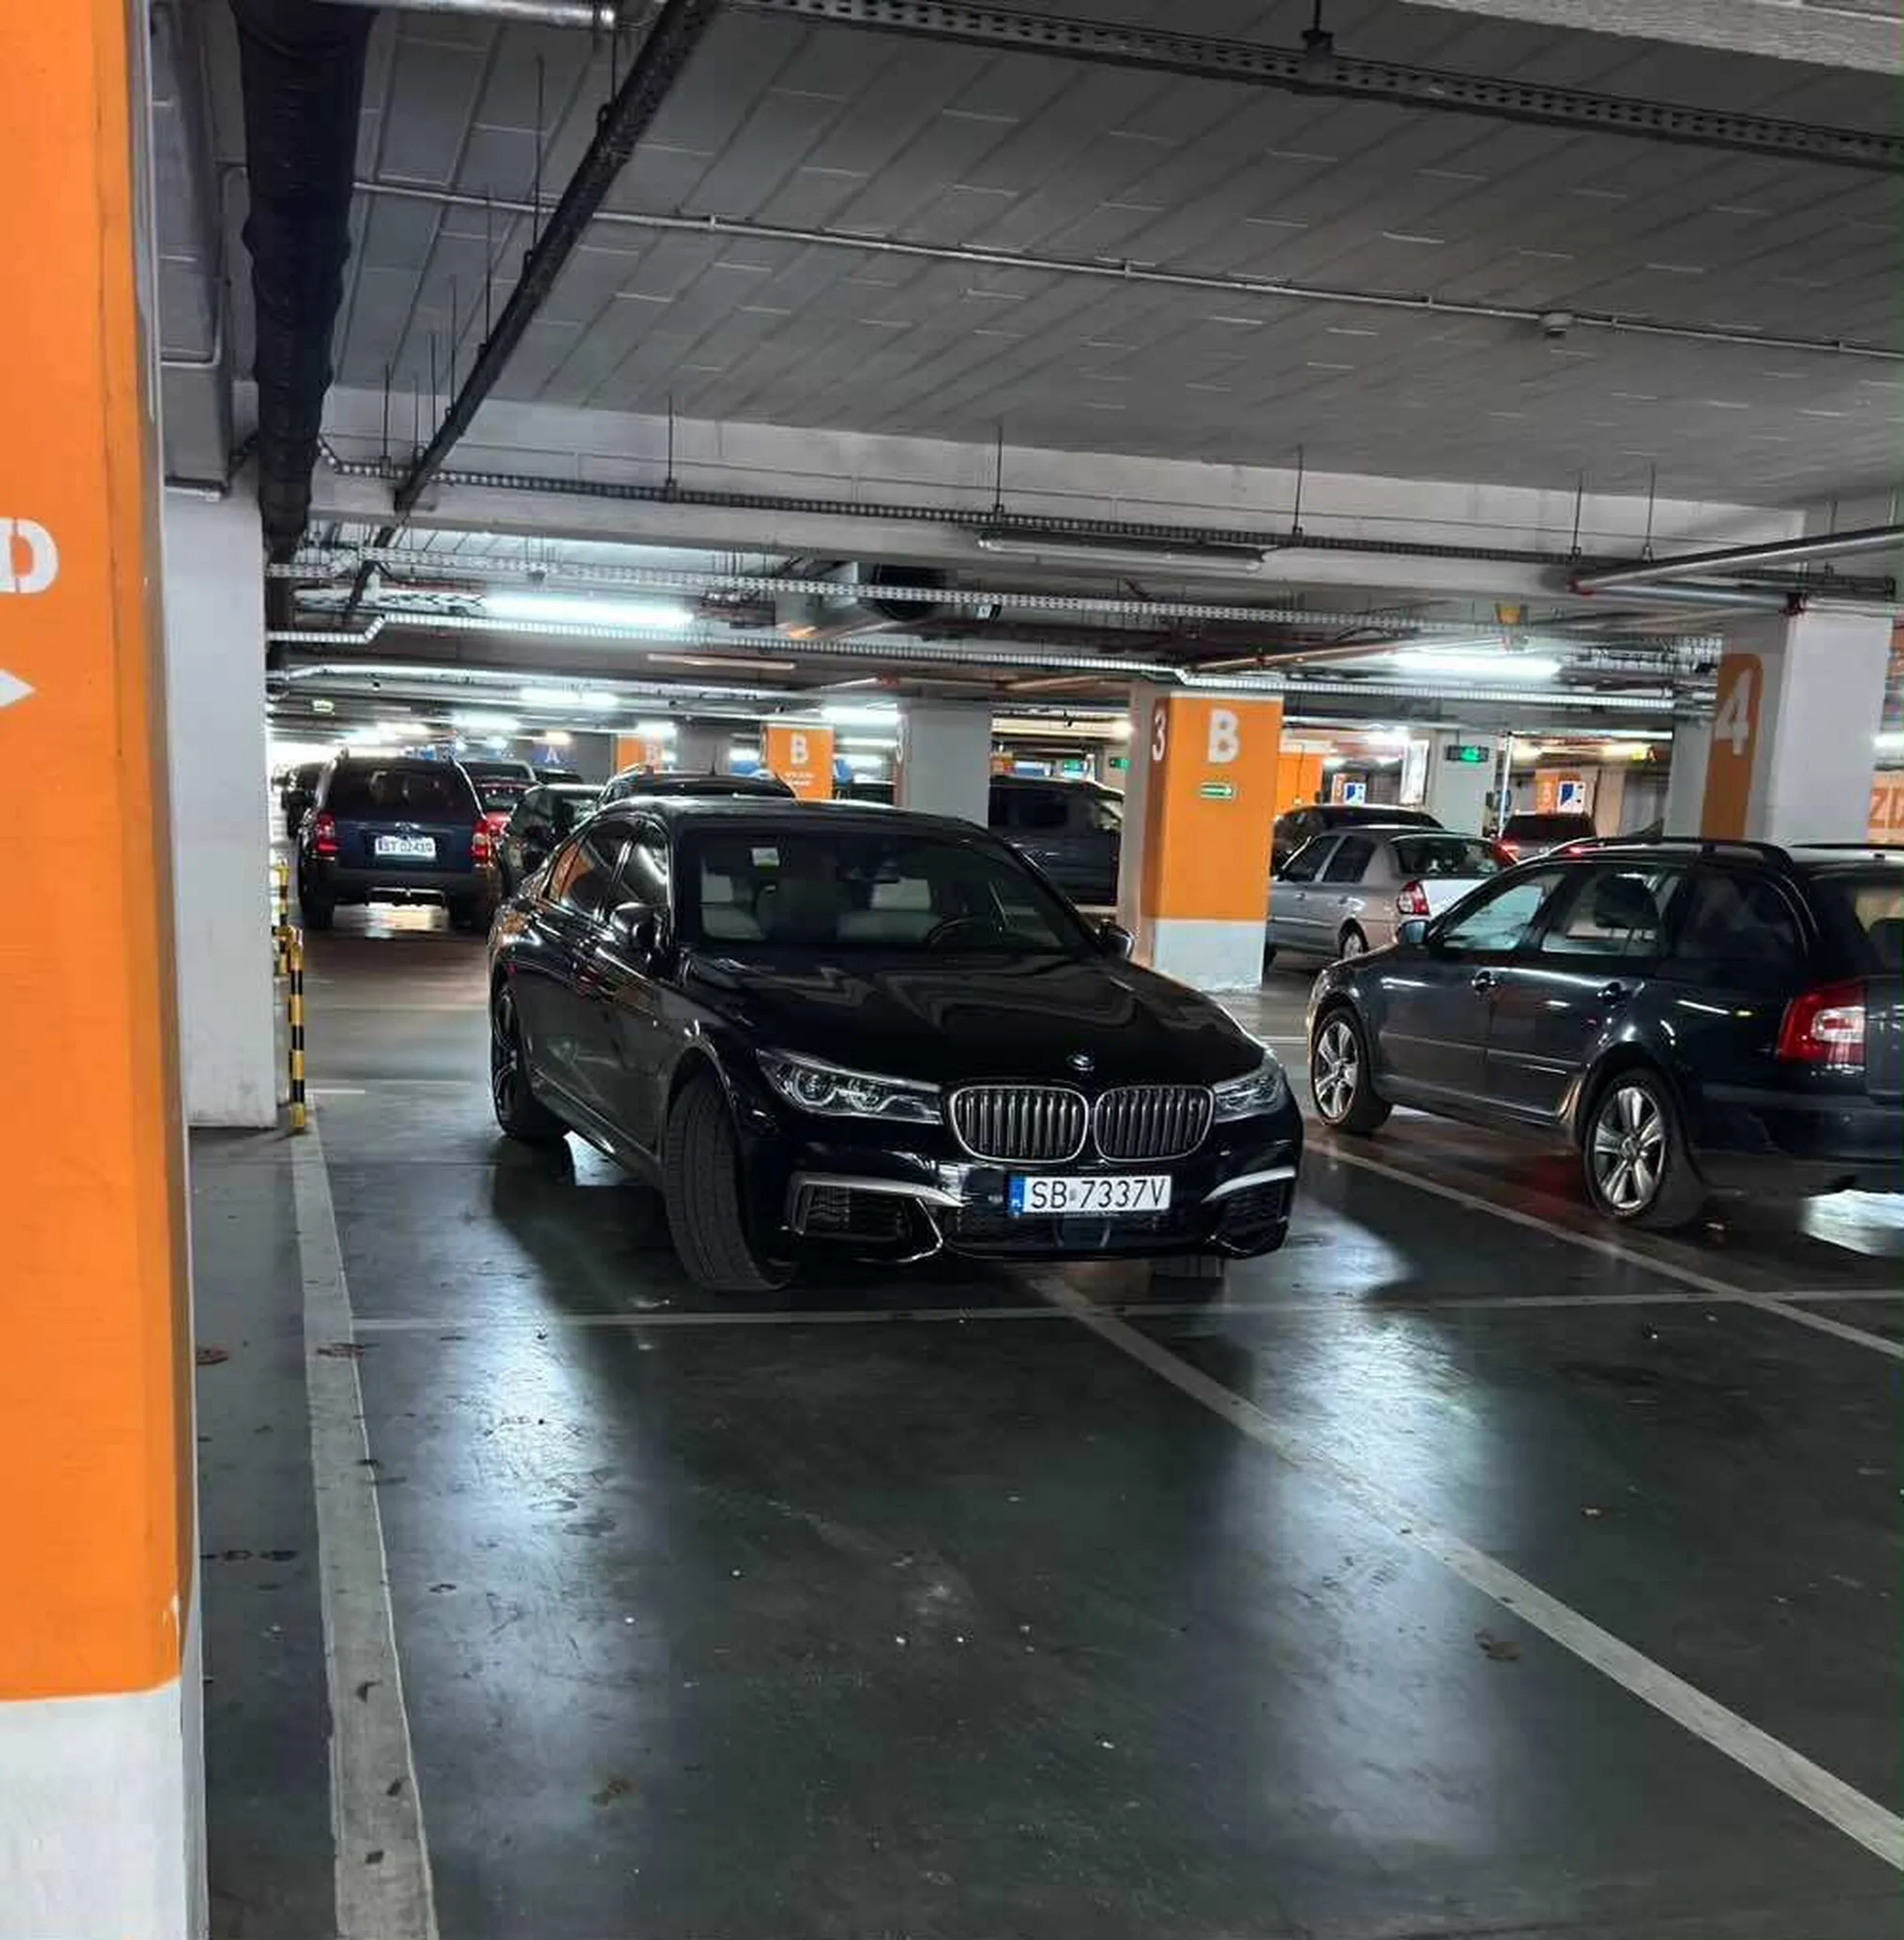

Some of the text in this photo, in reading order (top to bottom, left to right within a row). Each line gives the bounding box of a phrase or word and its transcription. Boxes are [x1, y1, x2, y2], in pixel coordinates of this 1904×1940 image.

[1152, 708, 1166, 761] 3
[1208, 709, 1240, 764] B
[1715, 668, 1753, 755] 4
[790, 733, 809, 764] B
[1032, 1178, 1166, 1209] SB 7337V
